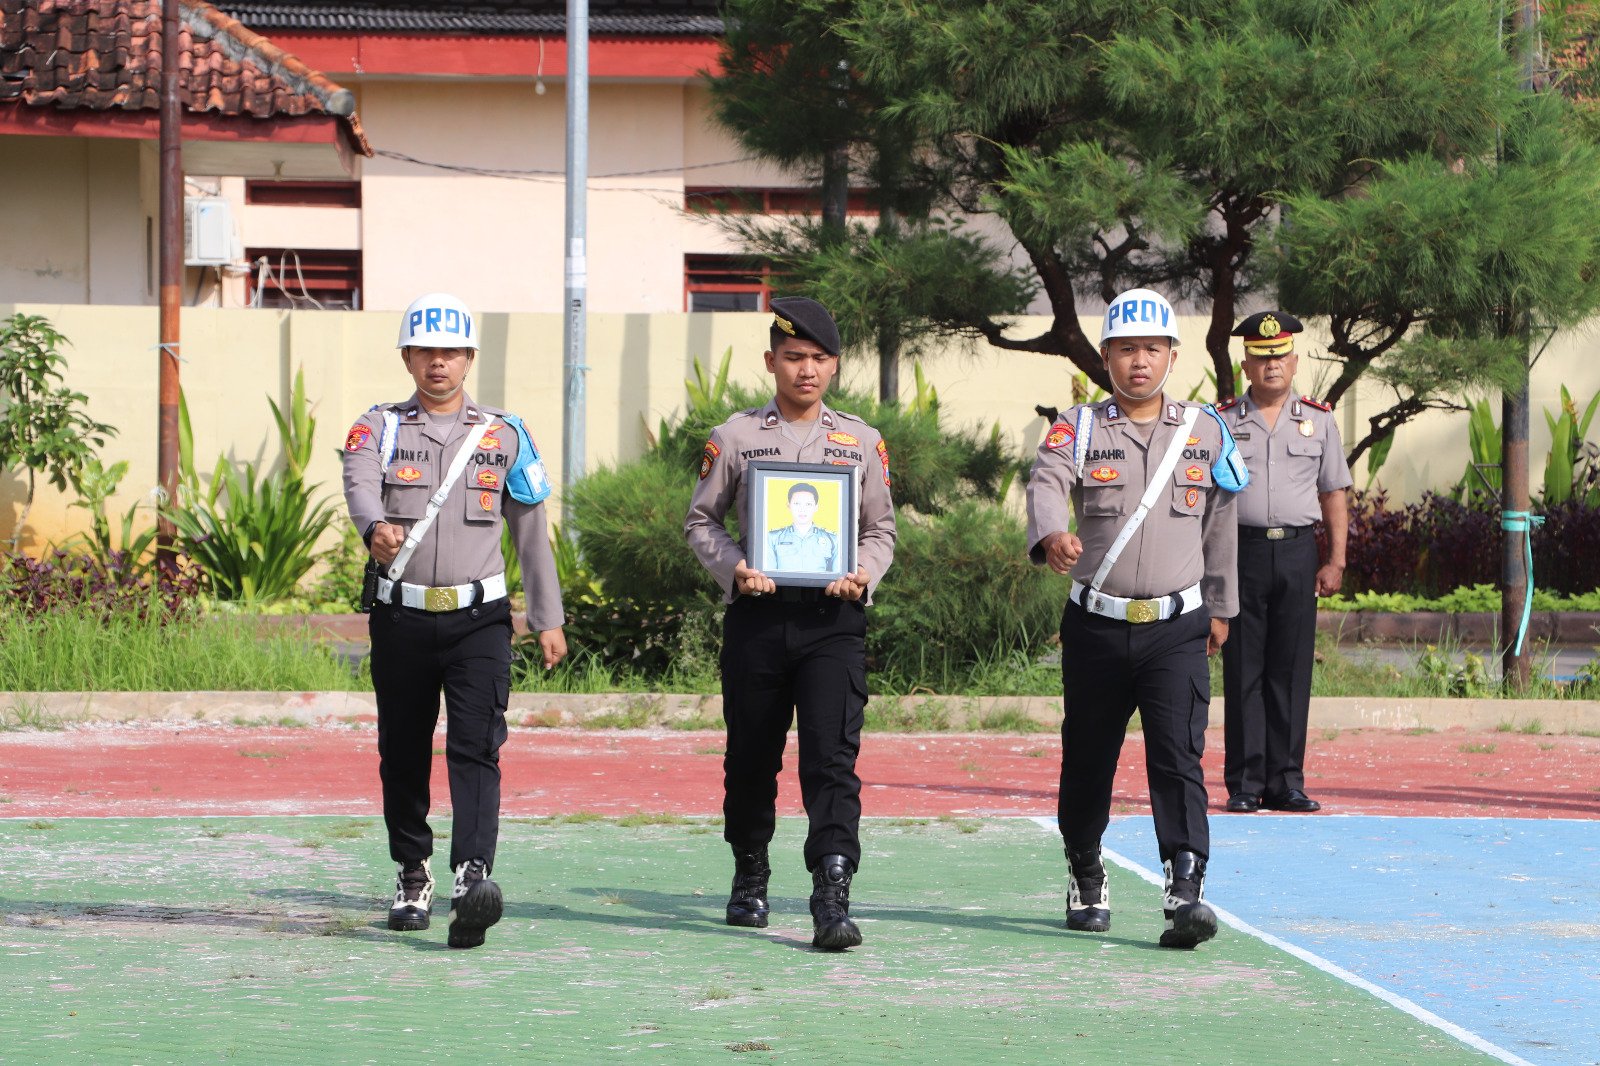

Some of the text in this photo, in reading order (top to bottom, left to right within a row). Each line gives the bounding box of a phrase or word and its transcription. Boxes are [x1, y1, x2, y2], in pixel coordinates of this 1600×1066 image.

[1108, 300, 1170, 331] PROV
[410, 308, 471, 339] PROV
[741, 447, 781, 460] YUDHA
[824, 447, 863, 462] POLRI
[1182, 448, 1210, 461] OLRI
